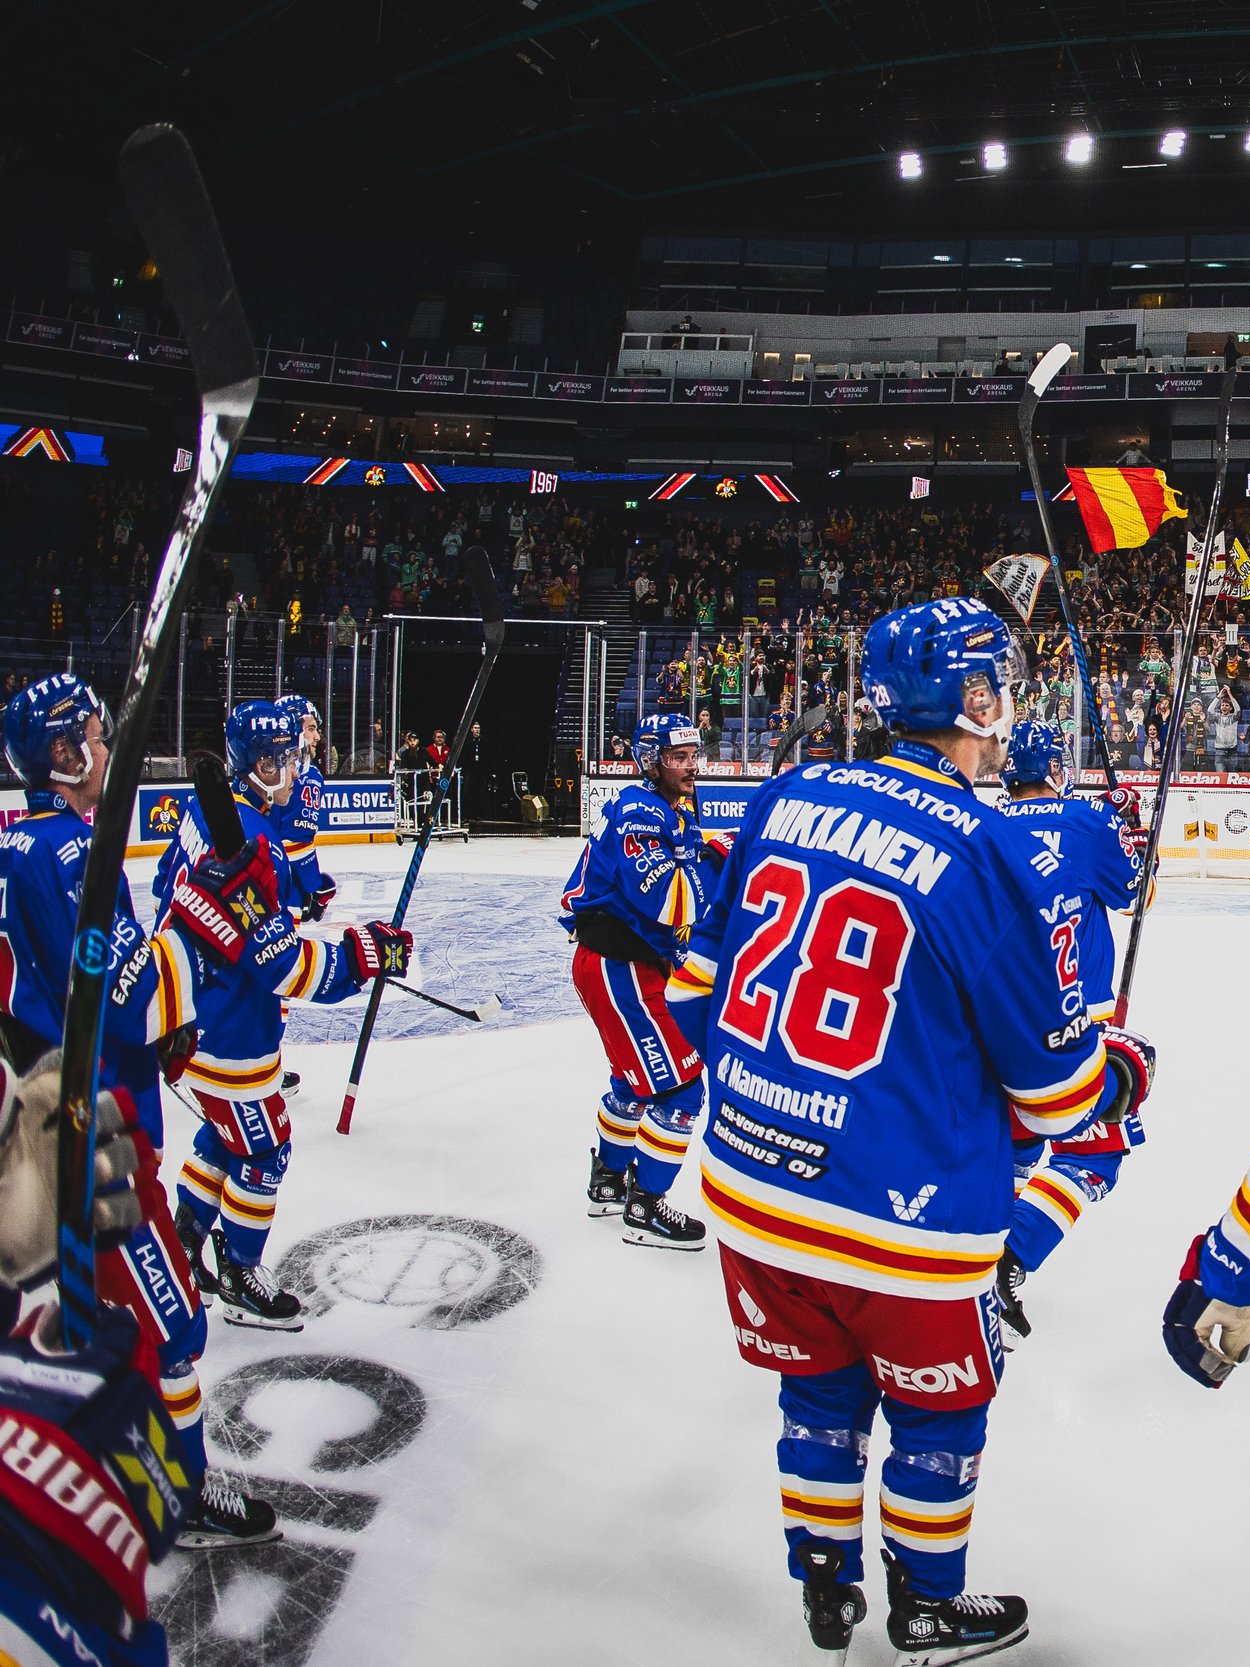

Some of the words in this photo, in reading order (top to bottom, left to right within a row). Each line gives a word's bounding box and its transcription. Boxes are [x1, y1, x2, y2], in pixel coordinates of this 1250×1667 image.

[838, 386, 869, 394] VEIKKAUS
[981, 384, 1013, 392] VEIKKAUS
[1170, 379, 1203, 387] VEIKKAUS
[530, 469, 559, 494] 1967
[871, 684, 892, 707] 28
[251, 717, 289, 731] ITIS
[590, 762, 634, 775] Redan
[700, 764, 735, 776] edan
[702, 801, 748, 817] STORE
[828, 769, 981, 836] CIRCULATION
[628, 822, 661, 833] VEIKKAUS
[761, 798, 952, 896] NIKKANEN
[635, 848, 666, 873] CHS
[1050, 914, 1080, 992] 2
[320, 945, 339, 995] KATEPLAN
[717, 854, 916, 1080] 28
[640, 1035, 670, 1081] HALTI
[728, 1061, 849, 1130] Mammutti
[713, 1120, 781, 1166] Rakennus
[789, 1158, 821, 1178] Oy
[136, 1243, 179, 1316] HALTI
[872, 1353, 980, 1393] FEON
[911, 1618, 931, 1636] KH
